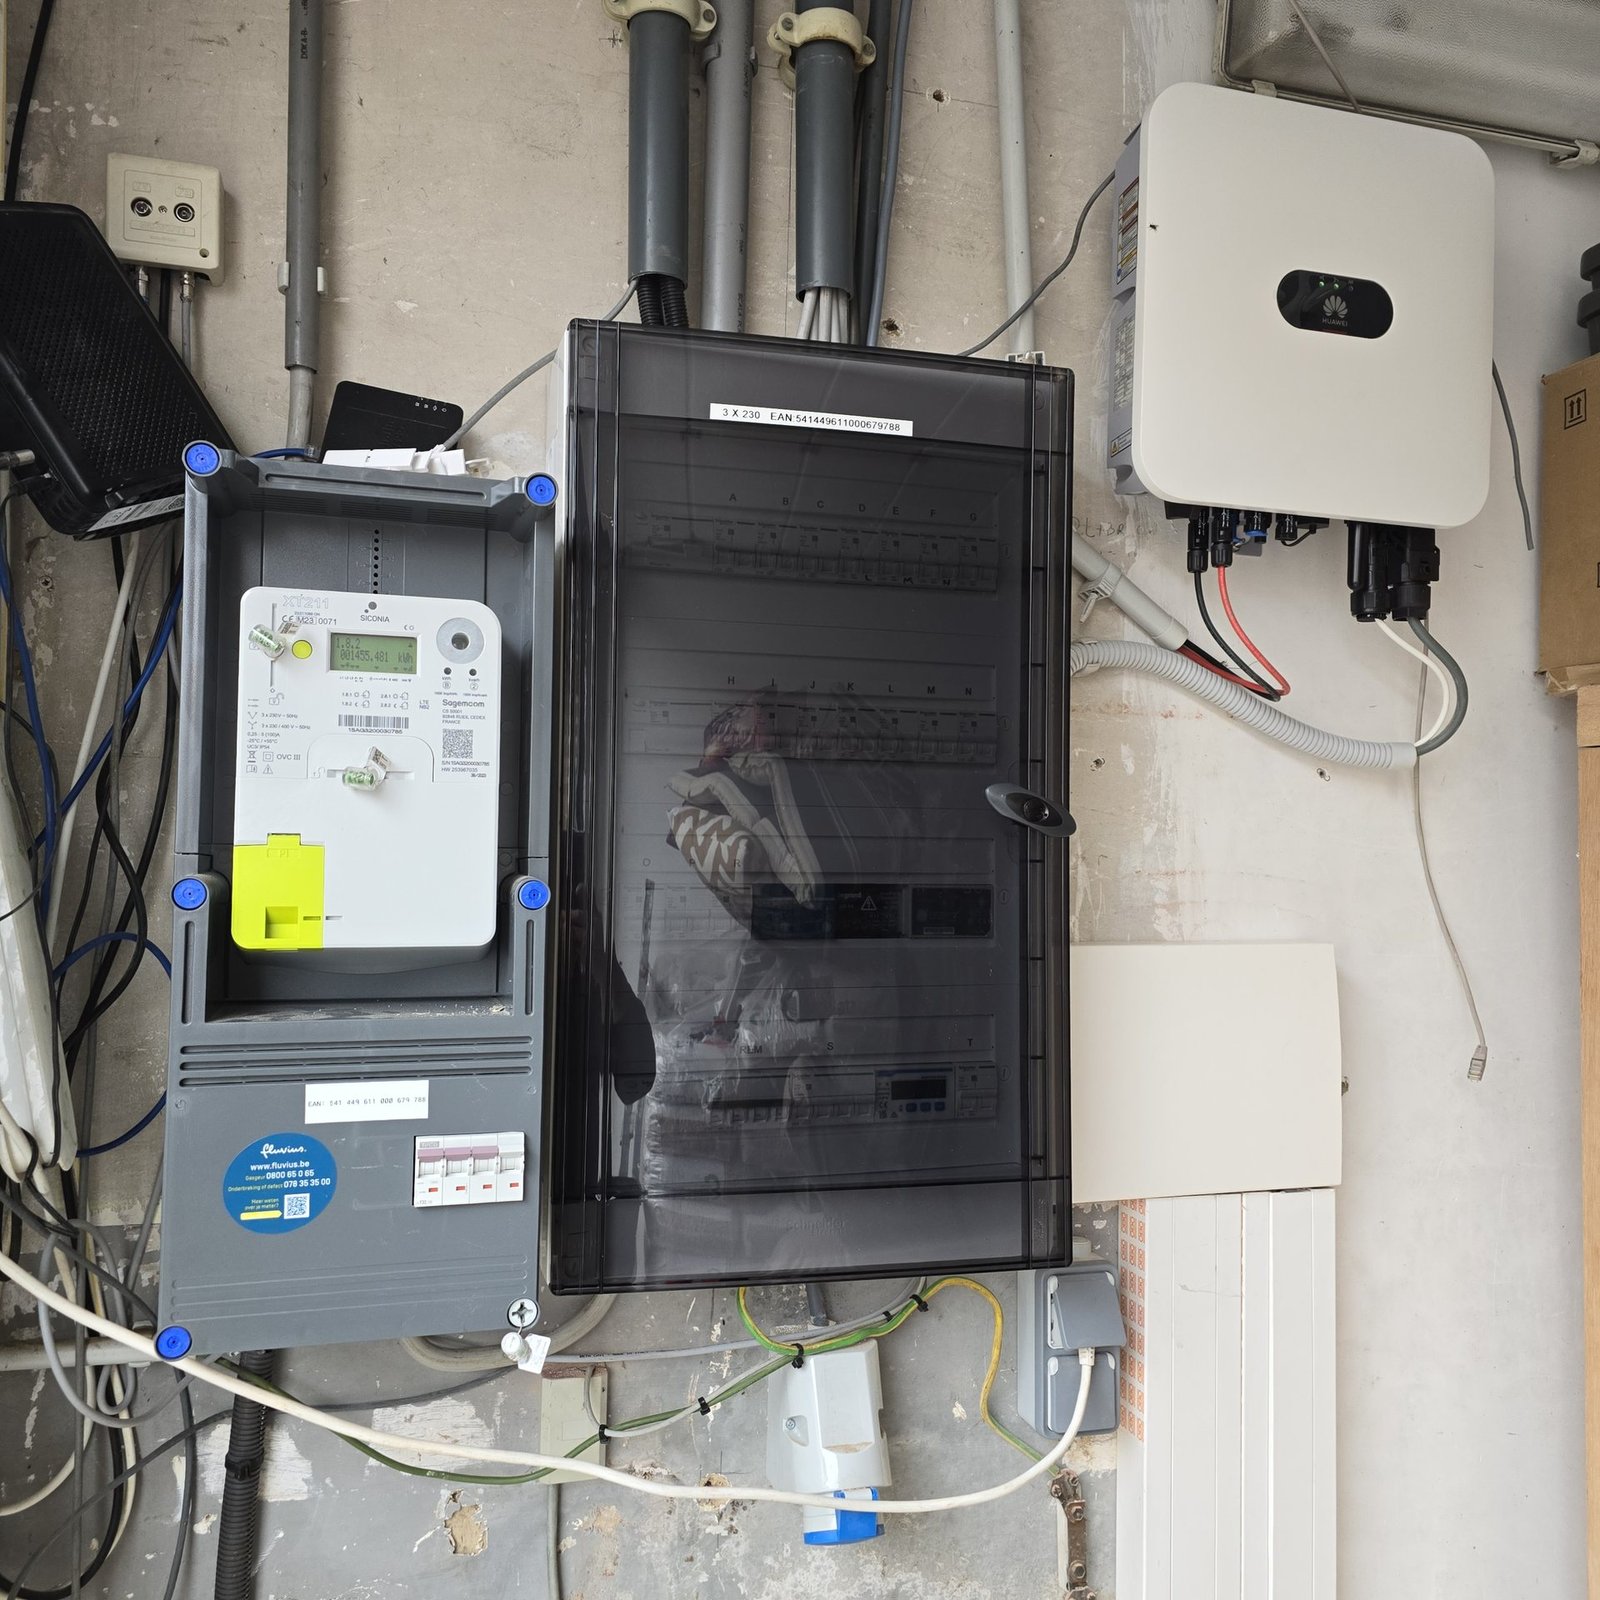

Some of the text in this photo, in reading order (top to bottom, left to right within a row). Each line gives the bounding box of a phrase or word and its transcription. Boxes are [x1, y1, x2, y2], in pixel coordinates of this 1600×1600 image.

[1322, 318, 1348, 327] HUAWEI
[722, 408, 729, 417] 3
[731, 409, 739, 418] X
[742, 410, 761, 420] 230
[729, 493, 737, 502] A
[782, 497, 789, 506] B
[816, 500, 825, 509] C
[858, 503, 866, 512] D
[892, 506, 899, 515] E
[930, 509, 936, 517] F
[282, 594, 329, 610] XT211
[318, 618, 337, 626] 0071
[360, 614, 390, 623] SICONIA
[335, 637, 361, 650] 1.8.2
[340, 649, 388, 663] 001455.481
[728, 676, 735, 685] H
[810, 680, 815, 689] J
[847, 682, 854, 691] K
[888, 684, 894, 693] L
[927, 686, 936, 694] M
[965, 688, 972, 696] N
[442, 698, 485, 708] Sagemcom
[826, 1042, 834, 1050] S
[968, 1038, 974, 1047] T
[346, 1098, 360, 1106] 449
[397, 1096, 410, 1104] 679
[250, 1160, 310, 1172] www.fluvius.be
[245, 1168, 315, 1182] Gasgeur 0800 65 0 65
[228, 1184, 260, 1192] Onderbreking
[284, 1180, 298, 1189] 078
[298, 1178, 309, 1188] 35
[309, 1178, 320, 1187] 35
[320, 1177, 332, 1186] 00
